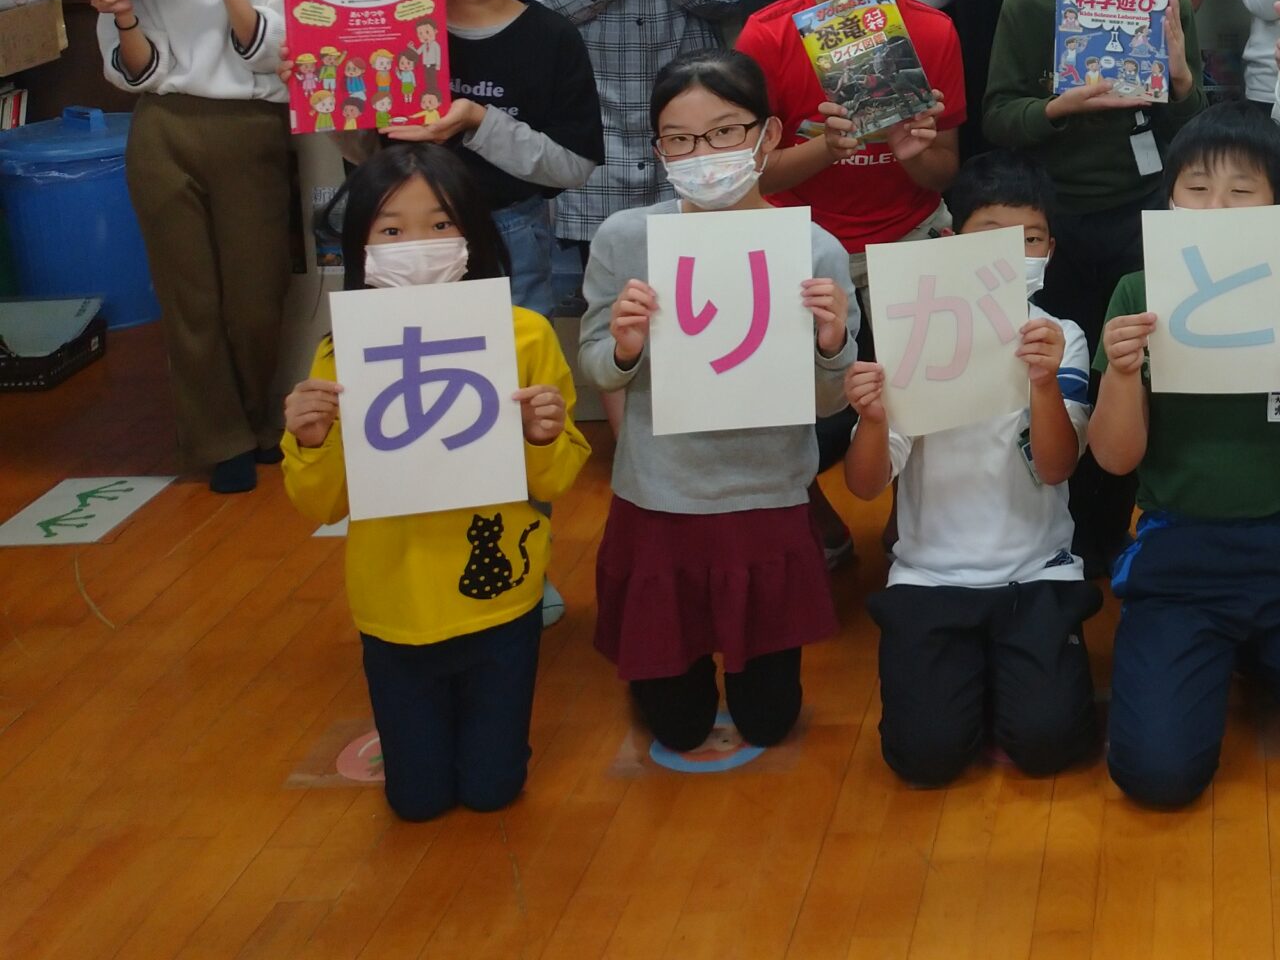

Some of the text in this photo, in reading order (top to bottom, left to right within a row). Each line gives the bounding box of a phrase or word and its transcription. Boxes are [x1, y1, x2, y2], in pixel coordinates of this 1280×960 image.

[815, 15, 866, 50] 恐竜
[834, 33, 886, 62] クイズ図鑑
[833, 152, 898, 167] ROLE
[676, 249, 771, 374] り
[886, 258, 1021, 389] が
[1169, 245, 1275, 348] と
[363, 325, 500, 452] あ
